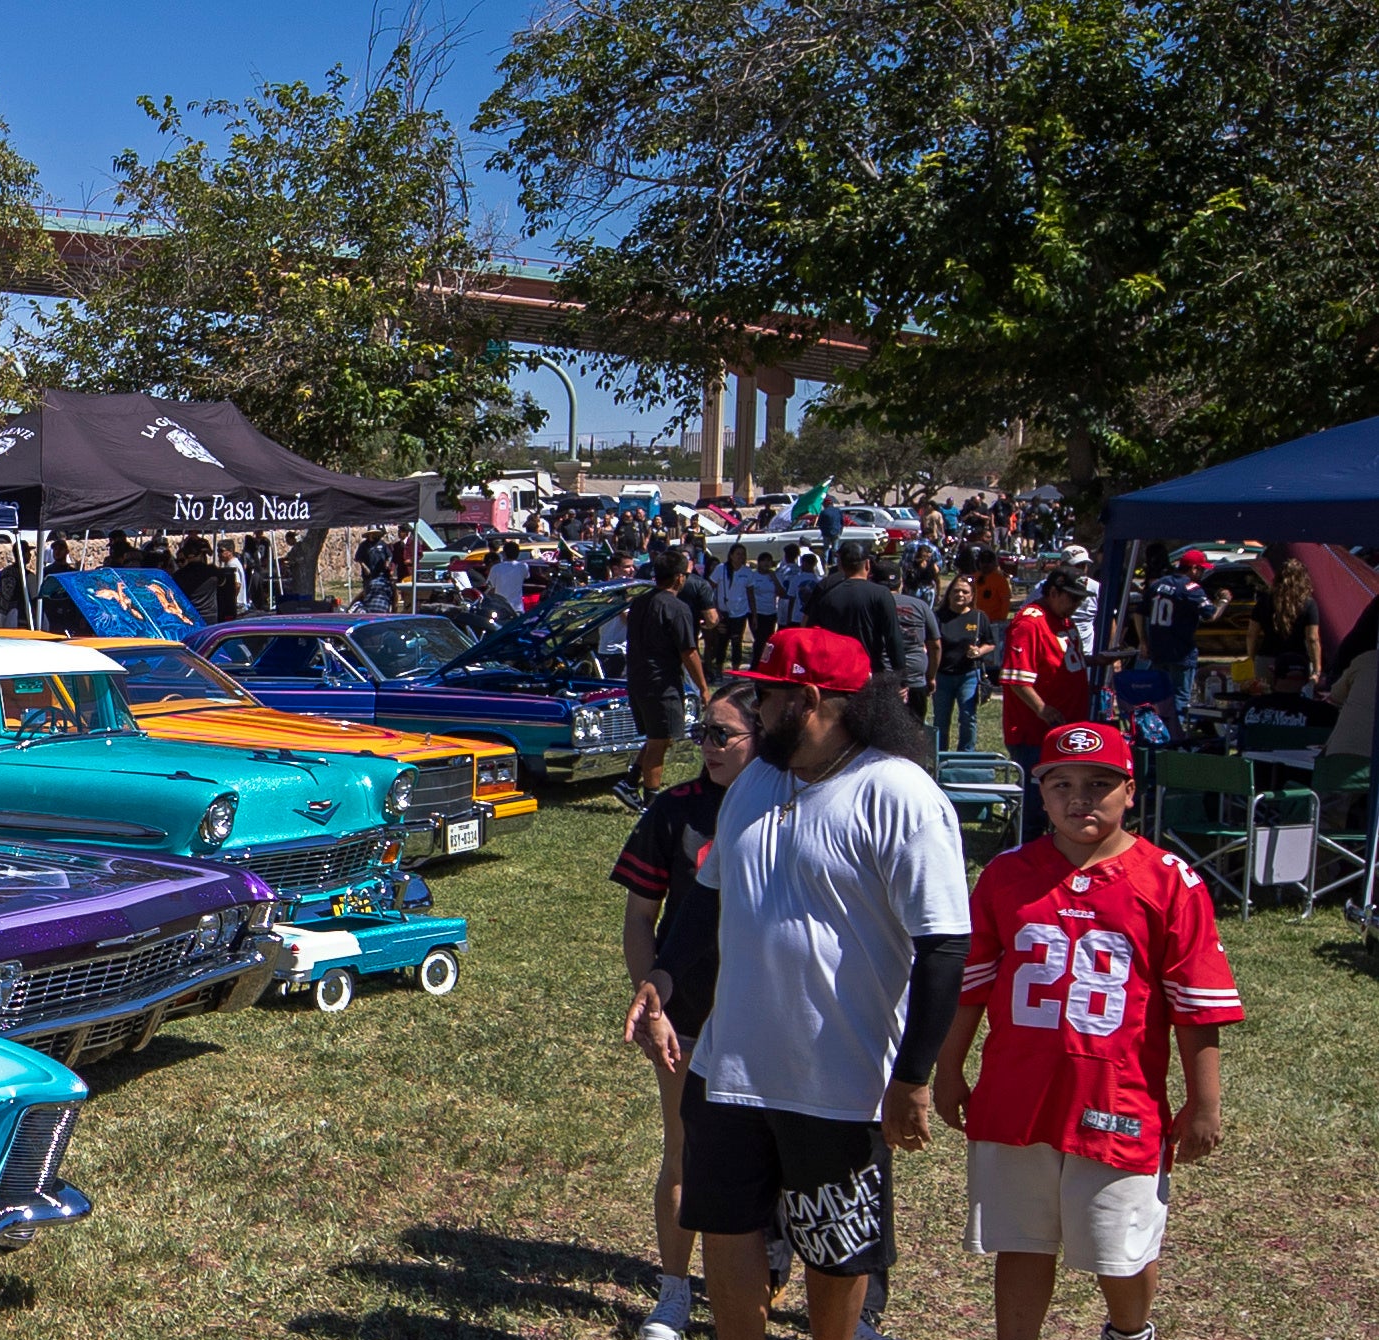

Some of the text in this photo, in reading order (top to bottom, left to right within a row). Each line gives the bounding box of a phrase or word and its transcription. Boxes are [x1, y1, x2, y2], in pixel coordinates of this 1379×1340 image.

[172, 492, 310, 520] No Pasa Nada
[1151, 596, 1173, 626] 10
[1012, 922, 1134, 1037] 28
